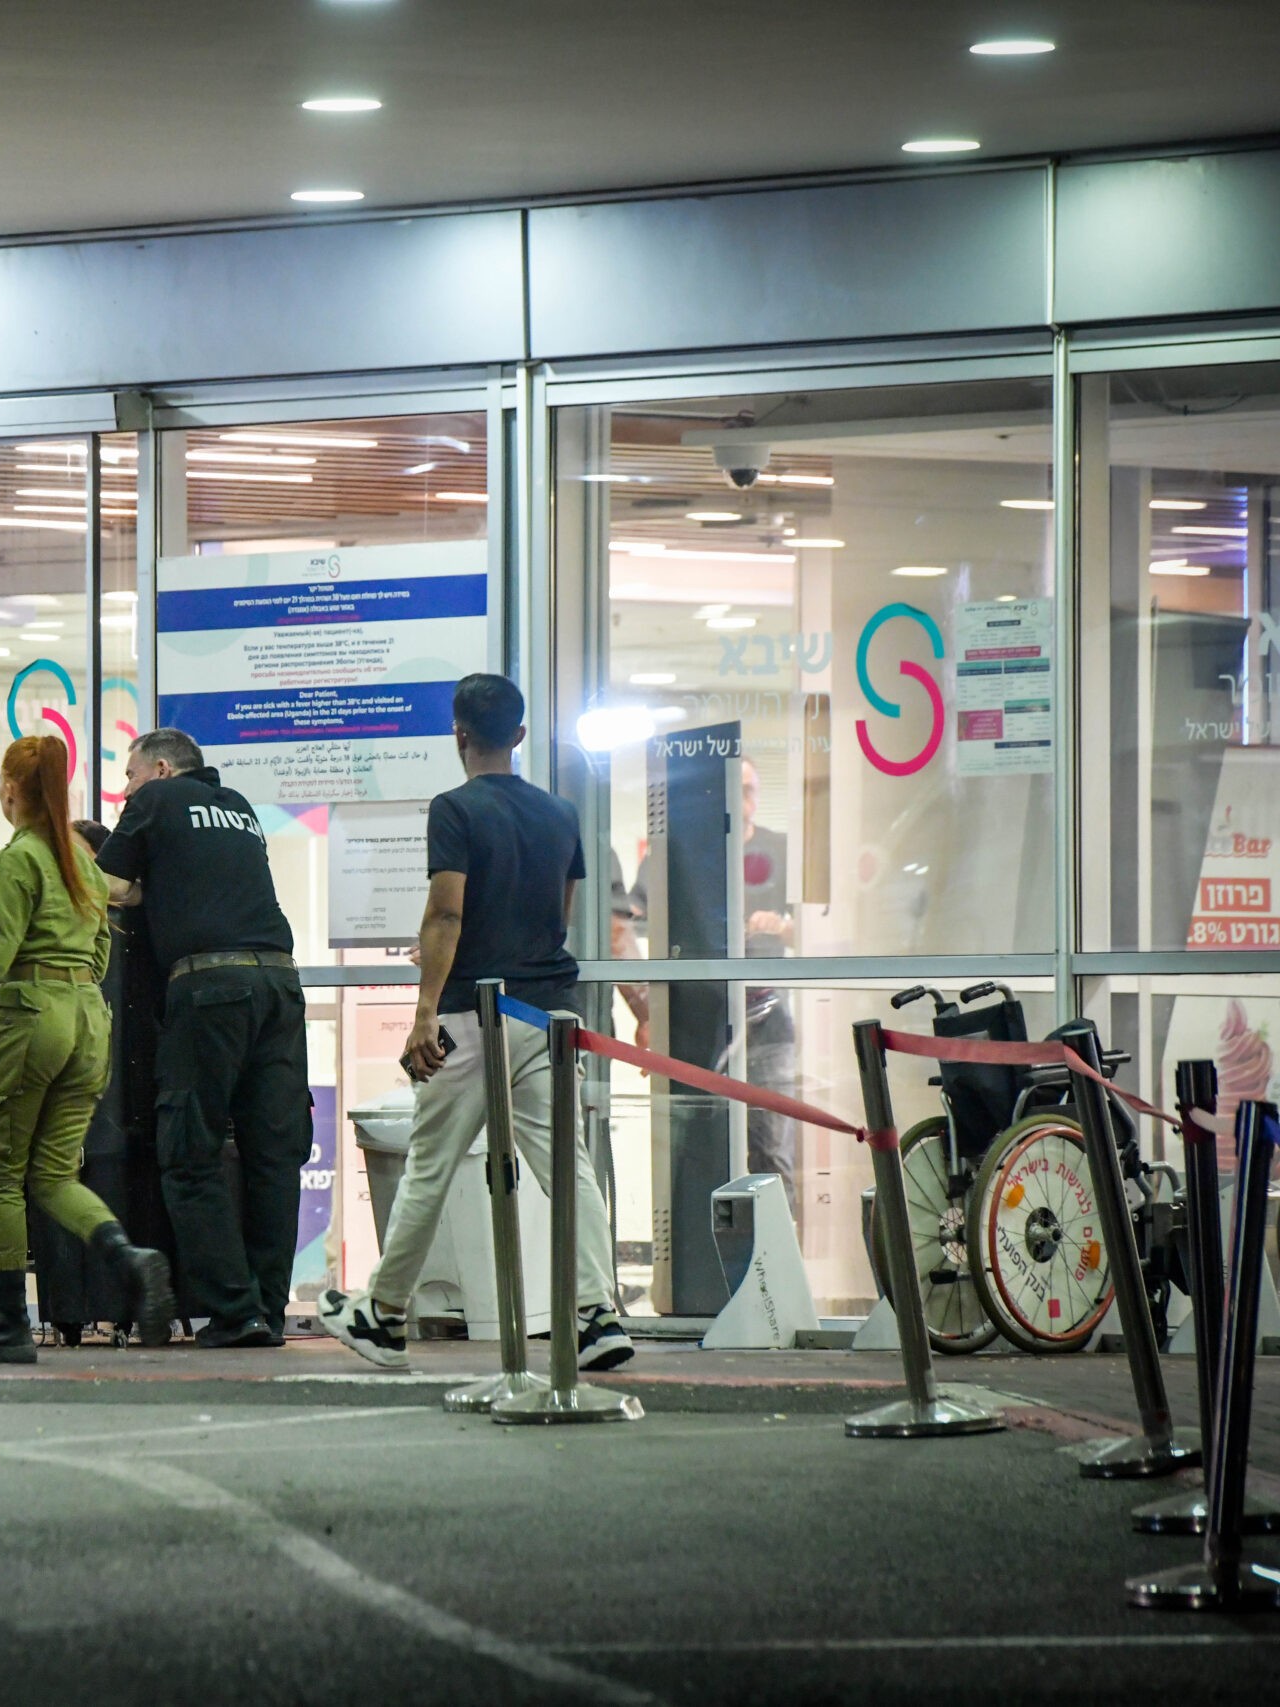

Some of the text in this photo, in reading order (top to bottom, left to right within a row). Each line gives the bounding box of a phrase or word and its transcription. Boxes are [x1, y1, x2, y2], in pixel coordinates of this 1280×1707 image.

[718, 633, 833, 677] שיבא
[1185, 717, 1239, 741] ישראל
[654, 736, 703, 758] ישראל
[706, 734, 731, 756] של
[1206, 884, 1265, 910] פרוזן
[997, 1226, 1027, 1276] הפועלי
[1025, 1272, 1046, 1302] בנק
